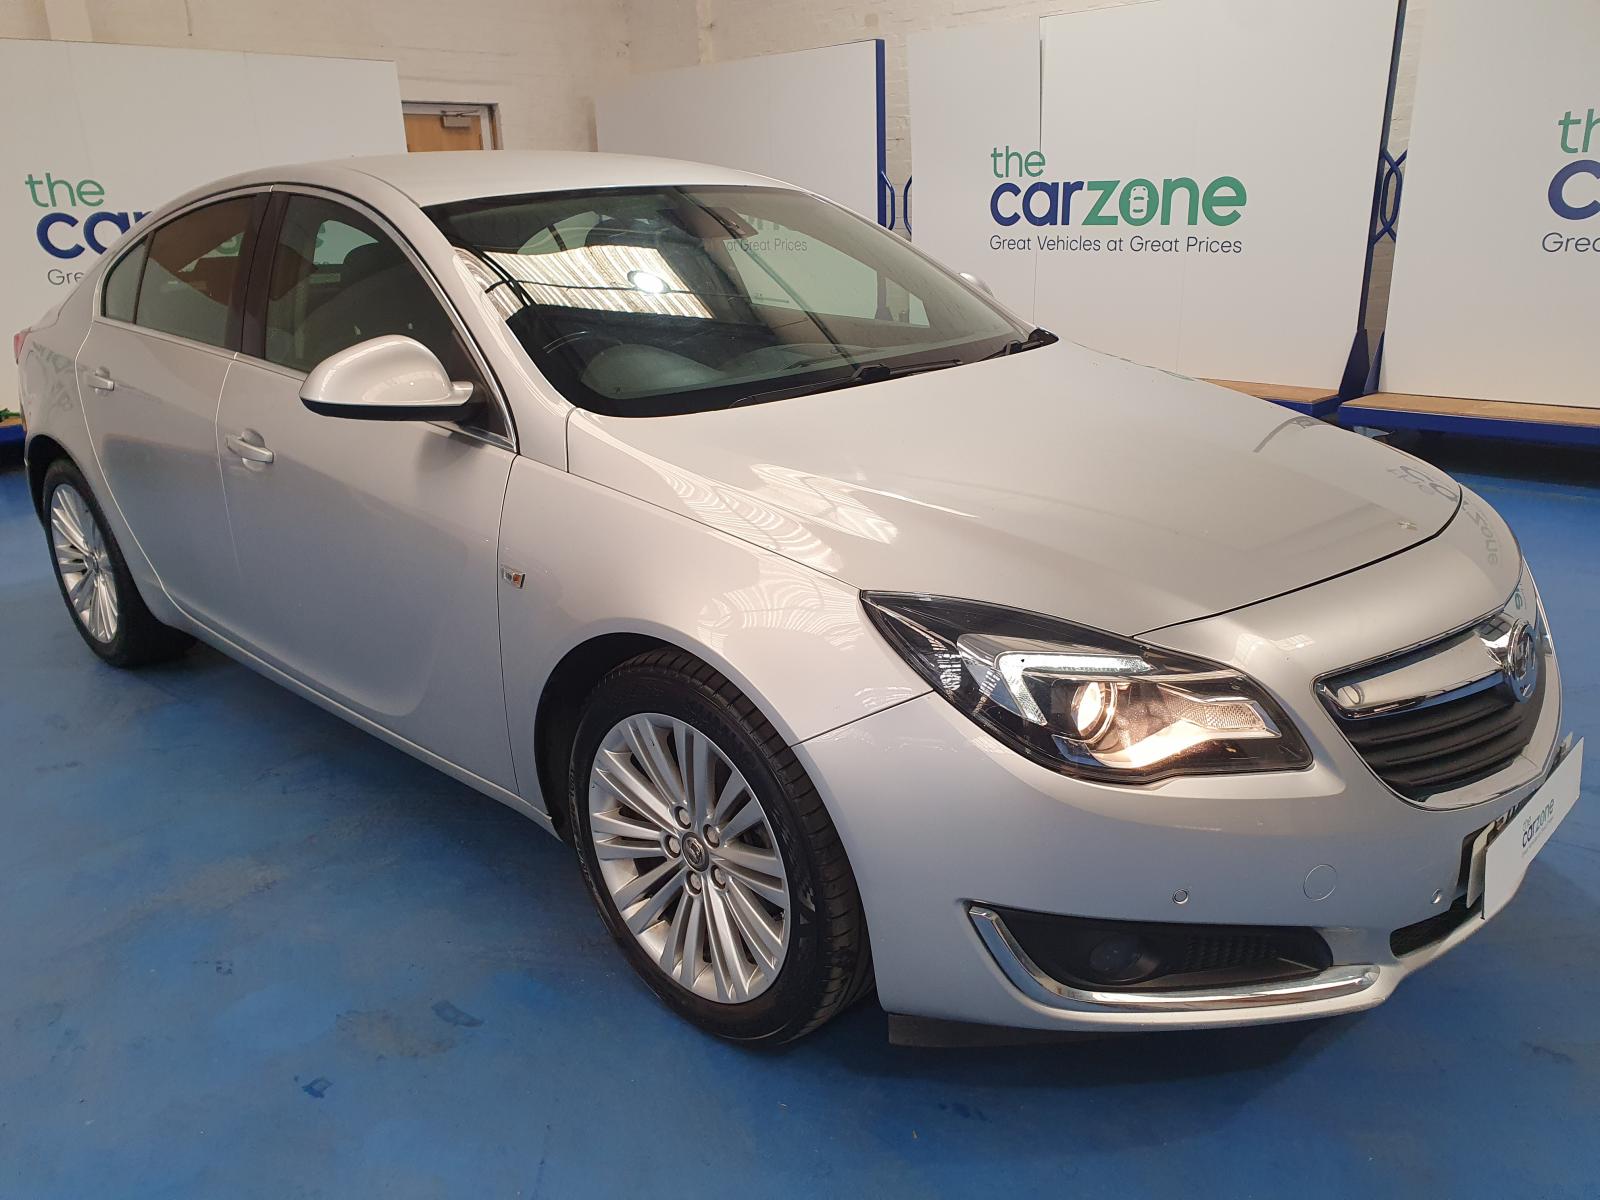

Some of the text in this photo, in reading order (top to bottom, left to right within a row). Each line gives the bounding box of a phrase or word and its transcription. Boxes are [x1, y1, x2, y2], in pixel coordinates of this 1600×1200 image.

[989, 145, 1046, 178] the
[25, 172, 105, 208] the
[989, 176, 1248, 227] carzone
[36, 211, 152, 260] ca
[740, 239, 771, 252] Great
[774, 238, 808, 252] Prices
[989, 234, 1243, 254] Great Vehicles at Great Prices
[1522, 798, 1555, 849] carzone
